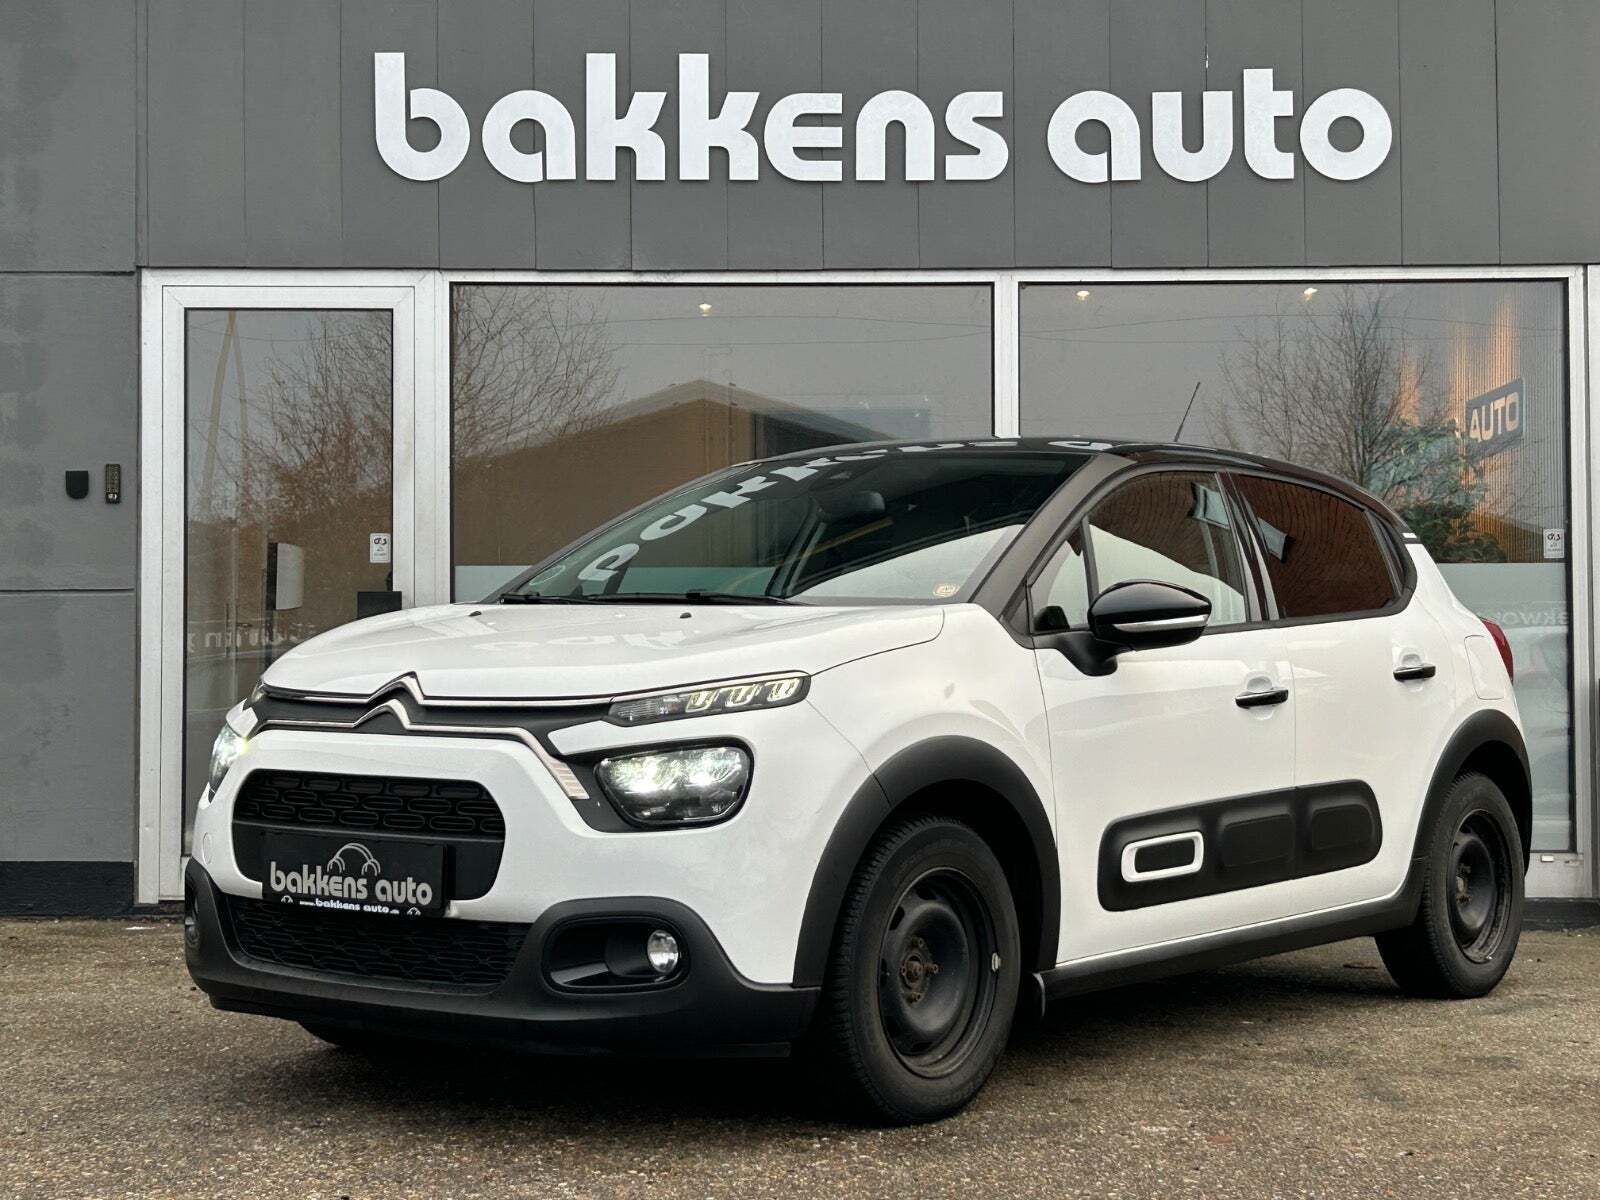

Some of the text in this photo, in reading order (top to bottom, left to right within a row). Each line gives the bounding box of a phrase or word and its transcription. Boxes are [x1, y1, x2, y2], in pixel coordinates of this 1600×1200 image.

[374, 51, 1393, 183] bakkens auto
[1469, 391, 1520, 443] AUTO
[269, 860, 433, 906] bakkens auto
